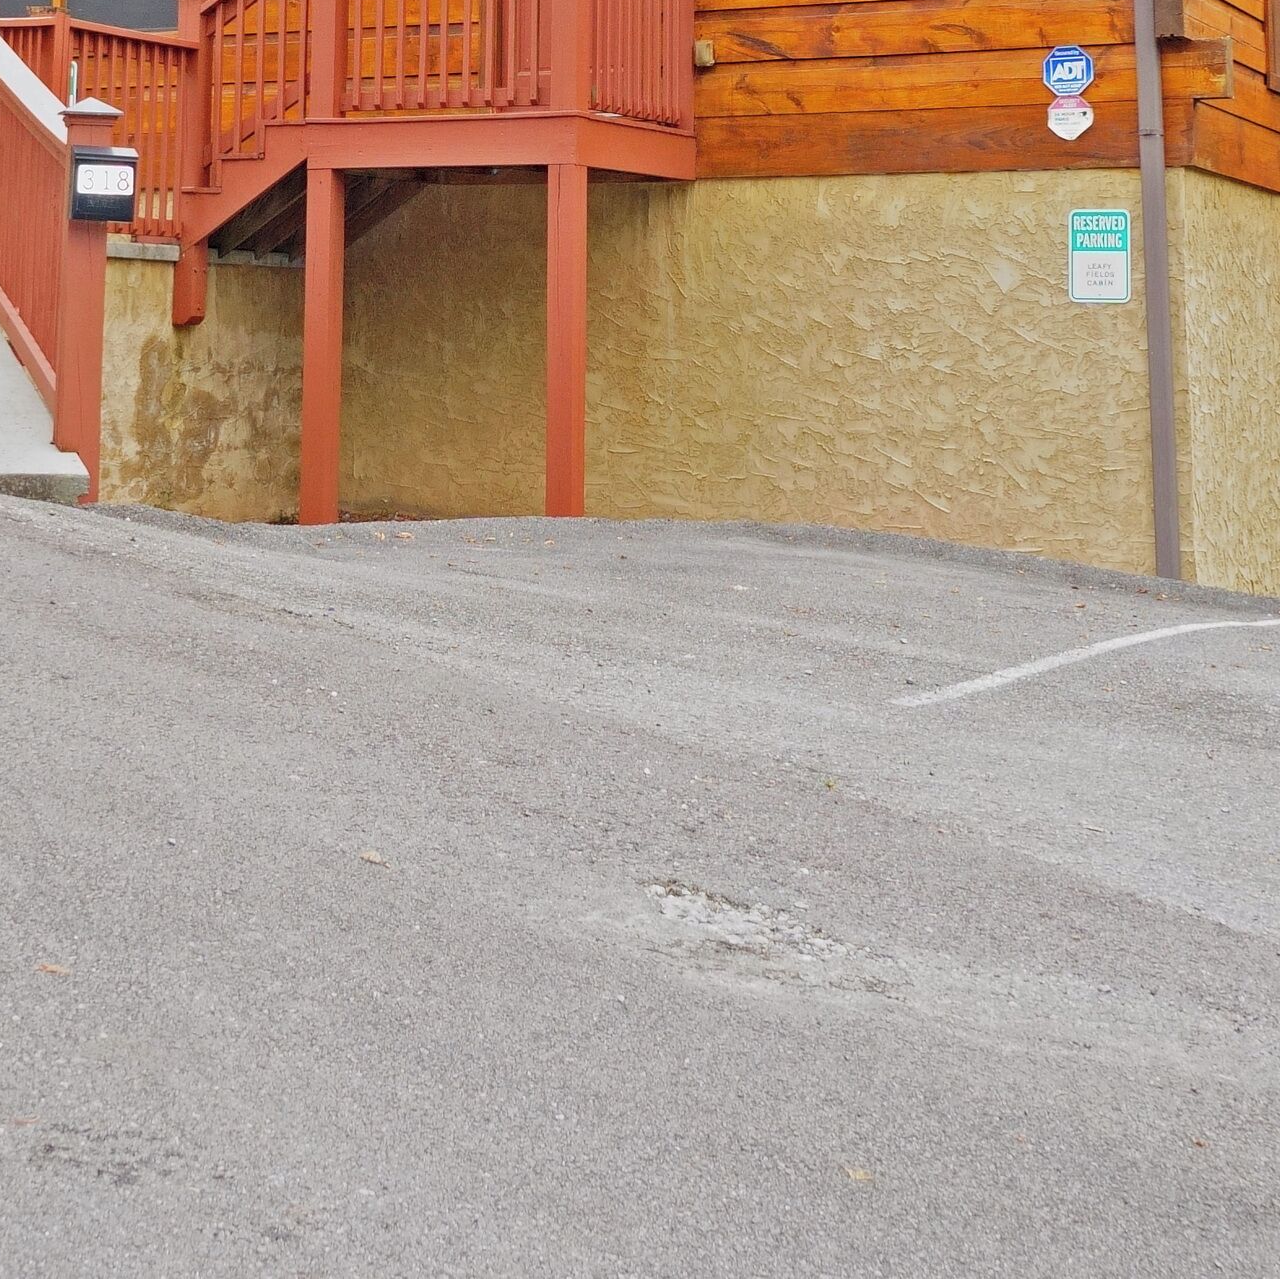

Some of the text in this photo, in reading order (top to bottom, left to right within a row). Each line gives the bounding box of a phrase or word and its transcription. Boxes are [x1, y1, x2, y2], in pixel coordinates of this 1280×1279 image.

[1052, 61, 1083, 81] ADT
[82, 169, 130, 191] 318
[1073, 215, 1125, 231] RESERVED
[1076, 233, 1122, 248] PARKING
